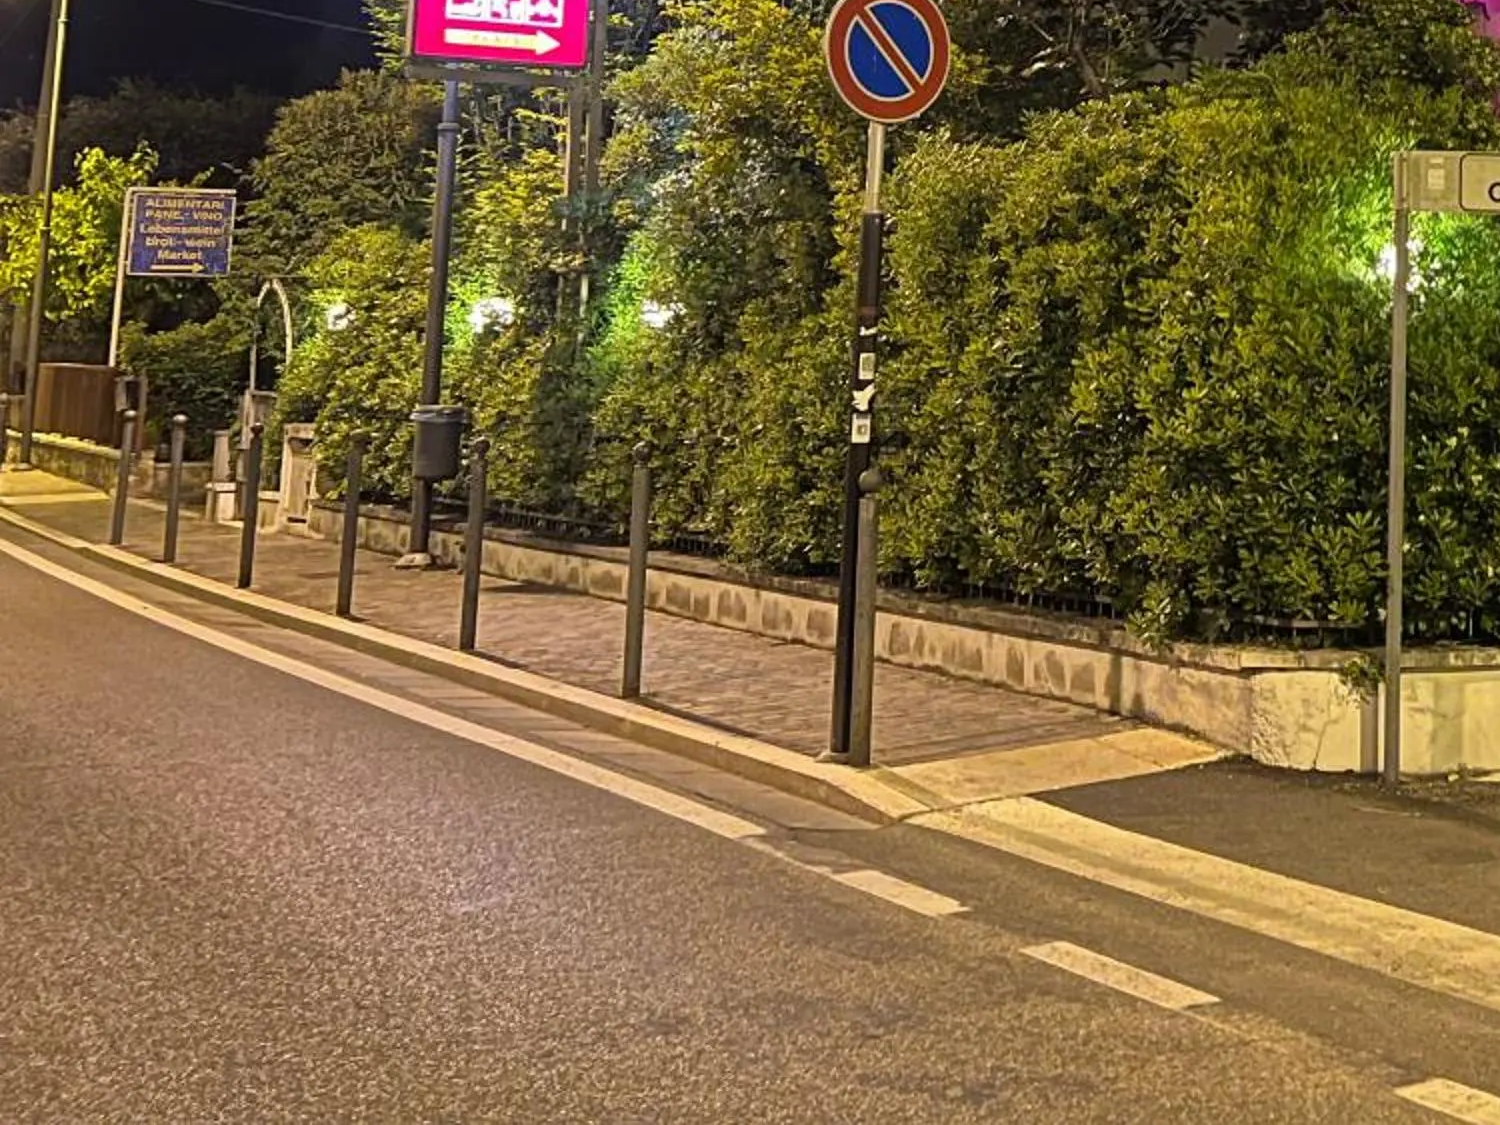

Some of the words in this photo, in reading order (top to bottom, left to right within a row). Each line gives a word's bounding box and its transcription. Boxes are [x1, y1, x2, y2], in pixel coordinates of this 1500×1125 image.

[145, 198, 225, 210] ALIMENTARI
[145, 210, 182, 220] PANE
[192, 211, 223, 221] VINO
